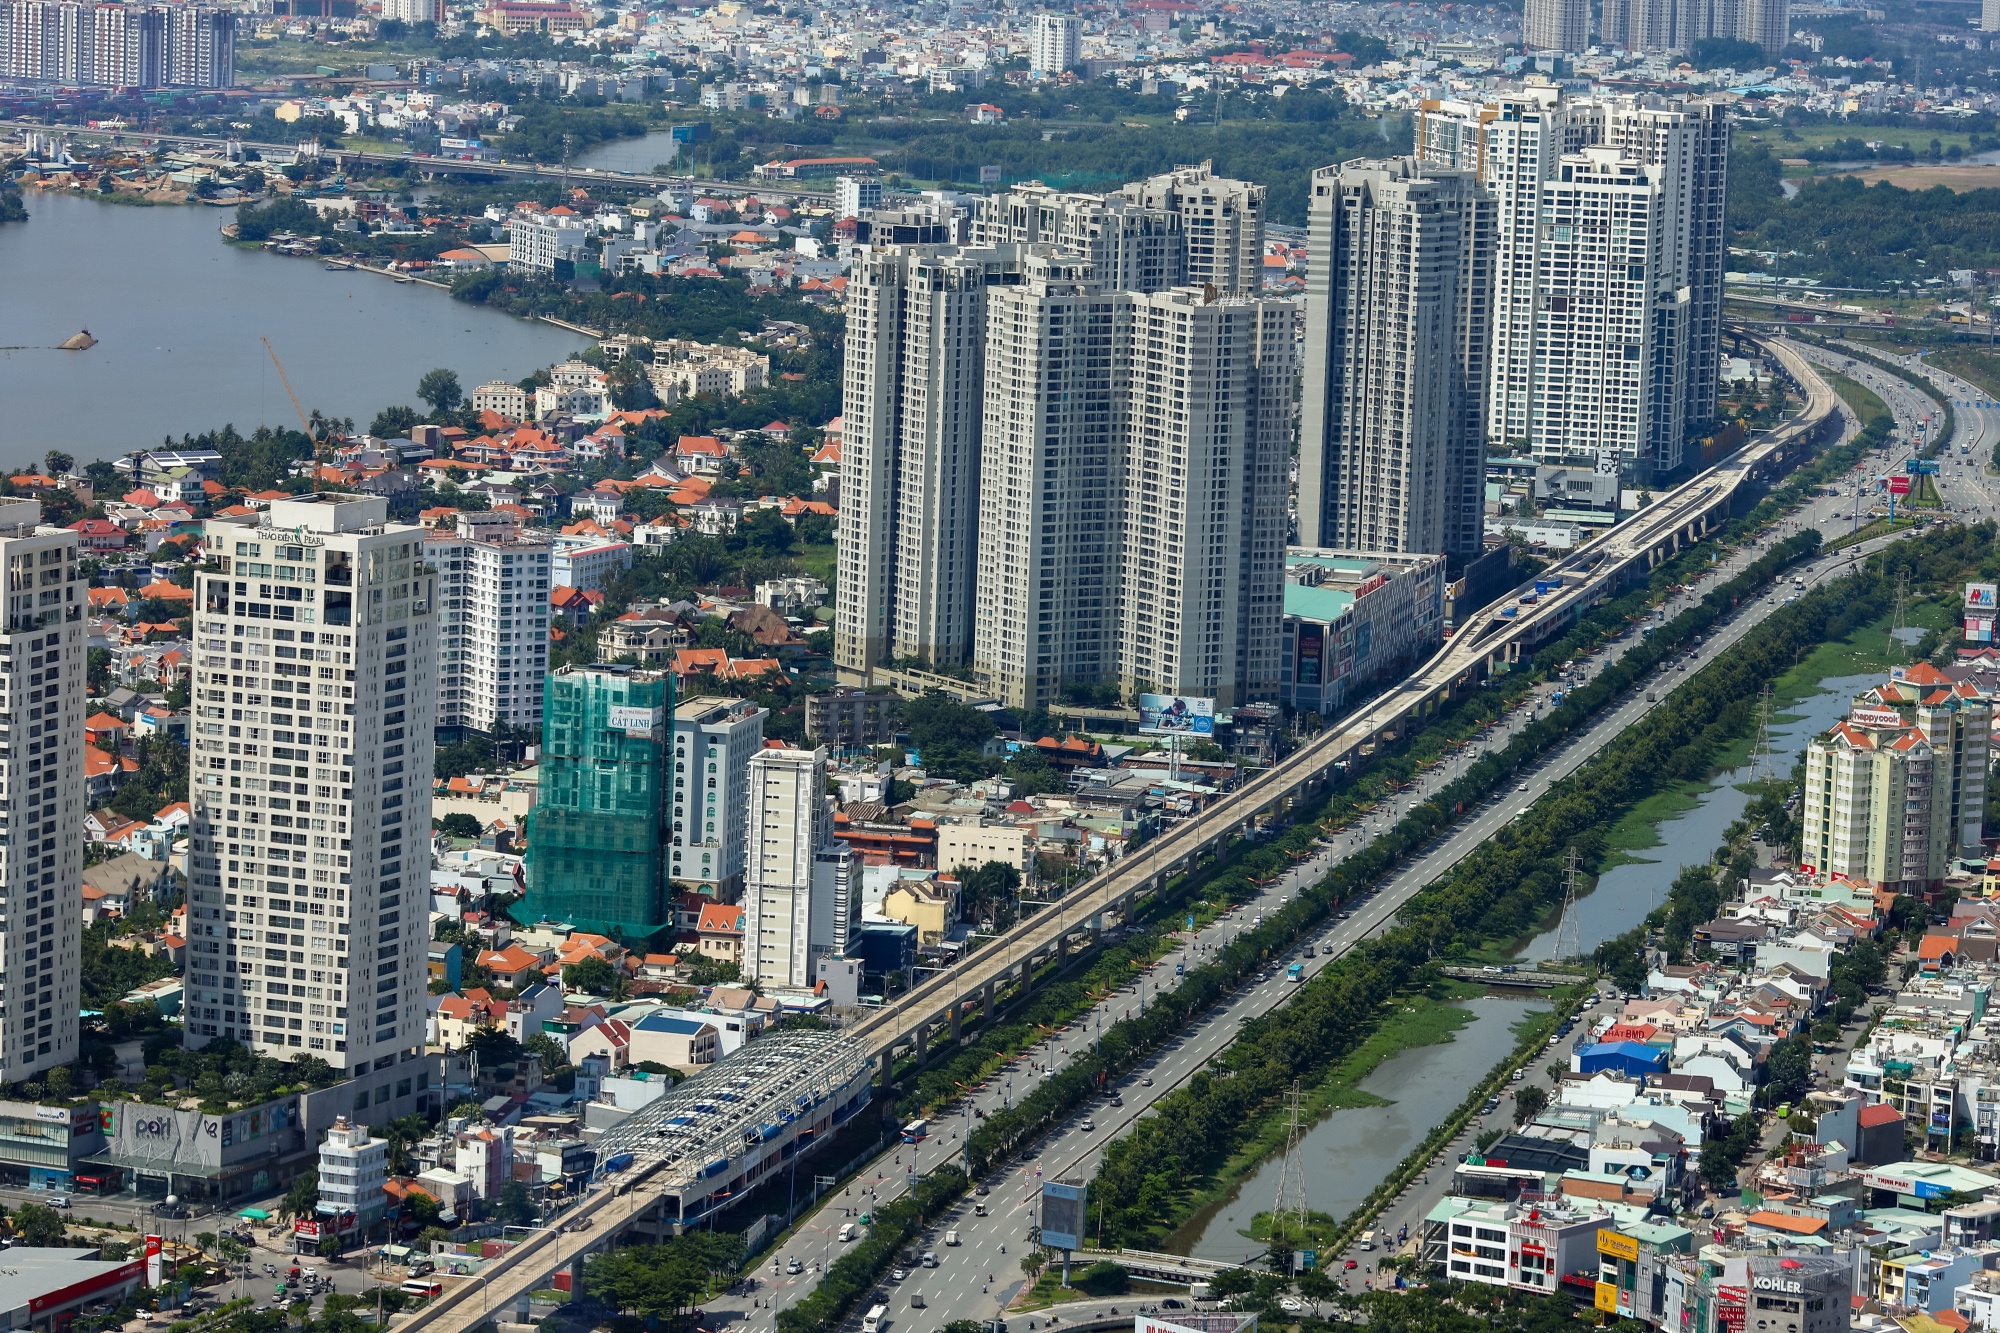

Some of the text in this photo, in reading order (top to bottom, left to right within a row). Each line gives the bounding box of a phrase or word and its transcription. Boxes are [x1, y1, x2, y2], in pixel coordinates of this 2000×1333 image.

[304, 535, 325, 545] PEARL
[630, 718, 650, 728] LINH
[1625, 1029, 1645, 1039] BMD
[1804, 1144, 1826, 1153] HOTEL
[1754, 1276, 1802, 1294] KOHLER
